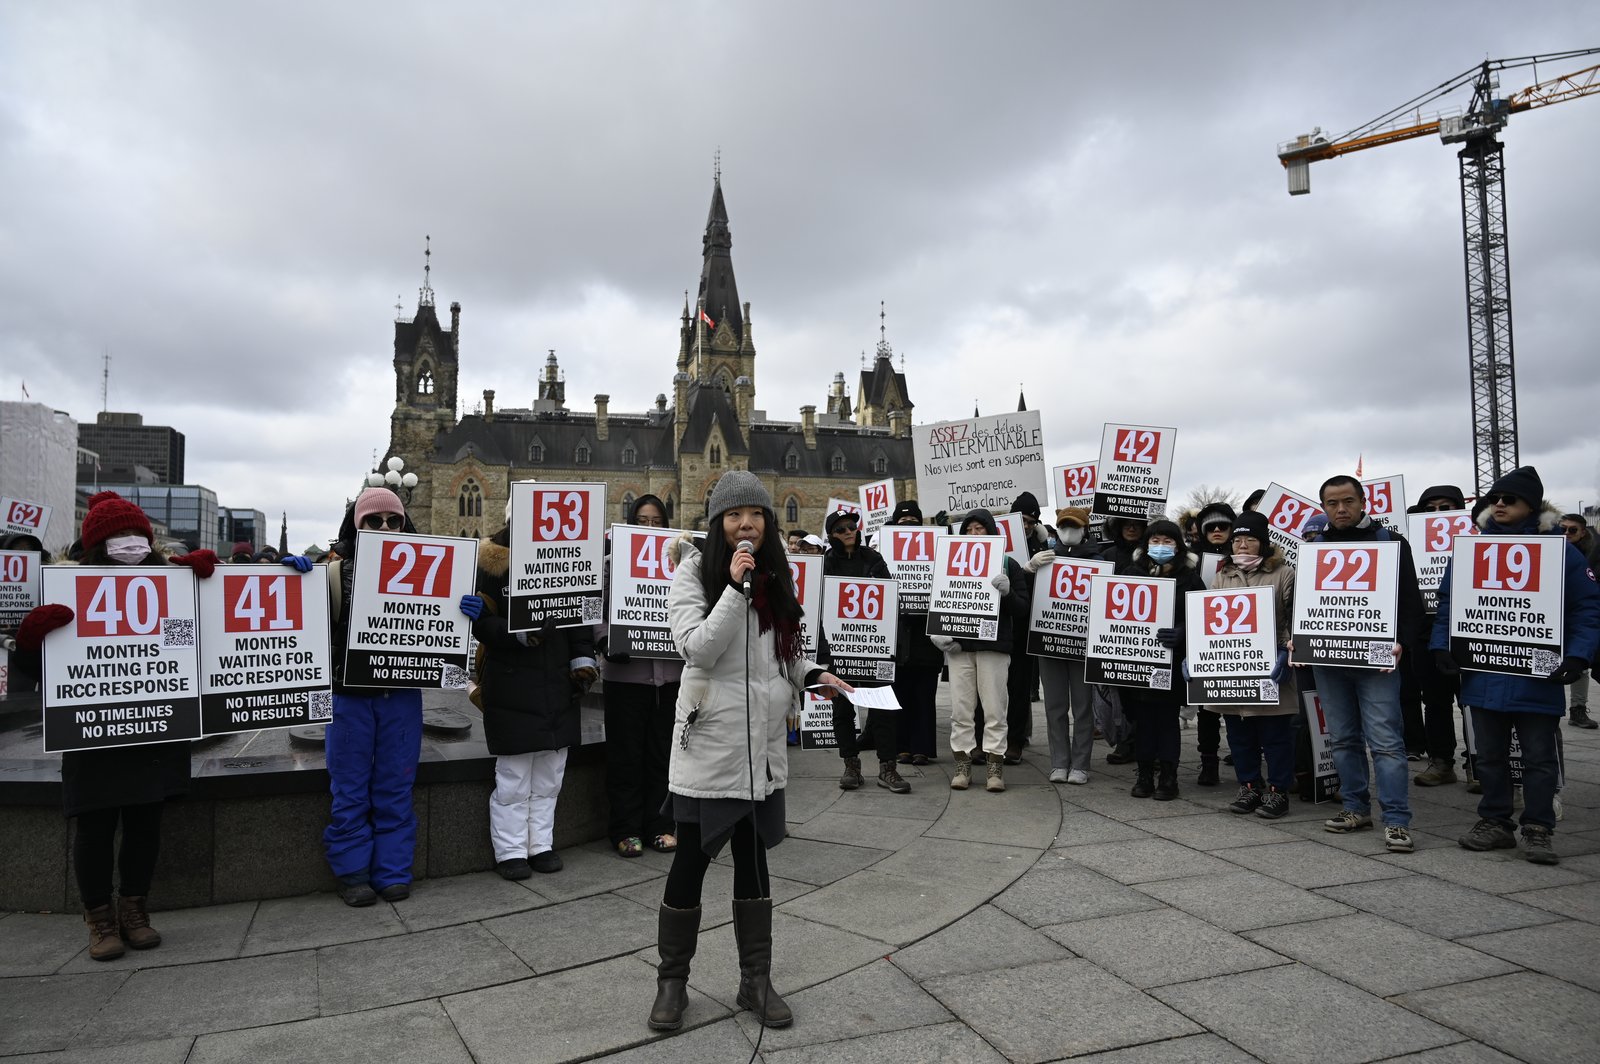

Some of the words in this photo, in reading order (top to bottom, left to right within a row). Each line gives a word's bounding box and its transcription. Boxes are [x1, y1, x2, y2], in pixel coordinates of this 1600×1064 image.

[929, 424, 969, 445] ASSEZ
[972, 423, 989, 438] des
[994, 419, 1023, 436] délais
[931, 429, 1042, 460] INTERMINABLE
[1119, 431, 1155, 462] 42
[924, 464, 941, 476] Nos
[944, 463, 962, 473] vies
[966, 457, 985, 471] sont
[989, 459, 1001, 467] en
[1005, 452, 1043, 467] suspens.
[1117, 465, 1151, 475] MONTHS
[1068, 467, 1093, 496] 32
[1107, 474, 1141, 484] WAITING
[1143, 477, 1159, 485] FOR
[948, 480, 1016, 494] Transparence.
[1101, 483, 1118, 491] IRCC
[1120, 484, 1163, 495] RESPONSE
[868, 485, 885, 510] 72
[949, 495, 978, 511] Délais
[1118, 498, 1148, 506] TIMELINE
[12, 503, 38, 526] 62
[539, 492, 583, 540] 53
[1120, 506, 1148, 514] RESULTS
[867, 518, 883, 526] WAITING
[1274, 499, 1315, 536] 81
[7, 525, 32, 533] MONTHS
[898, 532, 929, 560] 71
[537, 547, 581, 559] MONTHS
[952, 543, 986, 576] 40
[386, 543, 446, 595] 27
[525, 563, 569, 574] WAITING
[572, 561, 592, 572] FOR
[1322, 550, 1370, 589] 22
[1482, 544, 1531, 590] 19
[518, 578, 541, 590] IRCC
[543, 575, 597, 588] RESPONSE
[949, 581, 982, 589] MONTHS
[1056, 565, 1092, 600] 65
[843, 584, 879, 619] 36
[941, 591, 972, 599] WAITING
[974, 592, 990, 600] FOR
[1112, 584, 1152, 620] 90
[1320, 596, 1368, 606] MONTHS
[1478, 596, 1531, 608] MONTHS
[86, 577, 159, 635] 40
[234, 576, 293, 630] 41
[383, 602, 441, 616] MONTHS
[528, 600, 540, 609] NO
[934, 600, 951, 608] IRCC
[952, 602, 994, 611] RESPONSE
[1052, 602, 1088, 613] MONTHS
[532, 611, 544, 621] NO
[617, 609, 642, 621] IRCC
[1042, 611, 1078, 623] WAITING
[1210, 595, 1251, 634] 32
[1307, 608, 1354, 618] WAITING
[1358, 609, 1381, 619] FOR
[1465, 609, 1516, 622] WAITING
[1520, 612, 1545, 624] FOR
[368, 616, 425, 630] WAITING
[429, 620, 454, 632] FOR
[841, 623, 877, 632] MONTHS
[953, 625, 980, 633] RESULTS
[1035, 620, 1054, 630] IRCC
[1056, 622, 1088, 634] RESPON
[1110, 624, 1150, 635] MONTHS
[1300, 621, 1324, 630] IRCC
[1326, 622, 1387, 632] RESPONSE
[1458, 622, 1483, 633] IRCC
[1485, 624, 1553, 639] RESPONSE
[357, 632, 388, 645] IRCC
[390, 633, 461, 648] RESPONSE
[628, 630, 640, 639] NO
[832, 633, 867, 643] WAITING
[870, 635, 886, 643] FOR
[1100, 635, 1138, 646] WAITING
[1142, 638, 1160, 647] FOR
[235, 636, 297, 650] MONTHS
[632, 642, 644, 650] NO
[1054, 637, 1086, 646] TIMELINE
[1209, 639, 1251, 649] MONTHS
[1310, 639, 1322, 647] NO
[1325, 640, 1368, 649] TIMELINE
[87, 644, 160, 659] MONTHS
[829, 643, 845, 652] RCC
[846, 644, 890, 654] RESPONSE
[1045, 644, 1054, 652] NO
[1056, 646, 1086, 656] RESULTS
[1093, 646, 1113, 655] IRCC
[1115, 647, 1166, 659] RESPONSE
[1199, 652, 1240, 660] WAITING
[1244, 650, 1263, 659] FOR
[1328, 651, 1369, 659] RESULTS
[1469, 643, 1482, 651] NO
[1484, 644, 1537, 656] TIMELINE
[219, 654, 282, 669] WAITING
[285, 652, 313, 666] FOR
[369, 656, 385, 665] NO
[388, 656, 445, 667] TIMELINES
[845, 660, 877, 668] TIMELINE
[1194, 664, 1215, 672] IRCC
[1217, 662, 1270, 671] RESPONSE
[1473, 654, 1486, 663] NO
[1489, 655, 1532, 668] RESULTS
[68, 662, 143, 679] WAITING
[147, 661, 178, 676] FOR
[848, 668, 877, 676] RESULTS
[1114, 663, 1154, 672] TIMELINES
[210, 672, 243, 688] IRCC
[246, 667, 322, 685] RESPONSE
[373, 669, 389, 678] NO
[392, 669, 440, 680] RESULTS
[1117, 673, 1150, 681] RESULTS
[56, 683, 96, 699] IRCC
[100, 678, 189, 696] RESPONSE
[1207, 690, 1218, 698] NO
[226, 697, 242, 709] NO
[246, 692, 308, 707] TIMELINES
[76, 710, 95, 723] NO
[99, 705, 173, 722] TIMELINES
[232, 710, 248, 723] NO
[252, 707, 304, 720] RESULTS
[83, 725, 103, 738] NO
[107, 721, 167, 736] RESULTS
